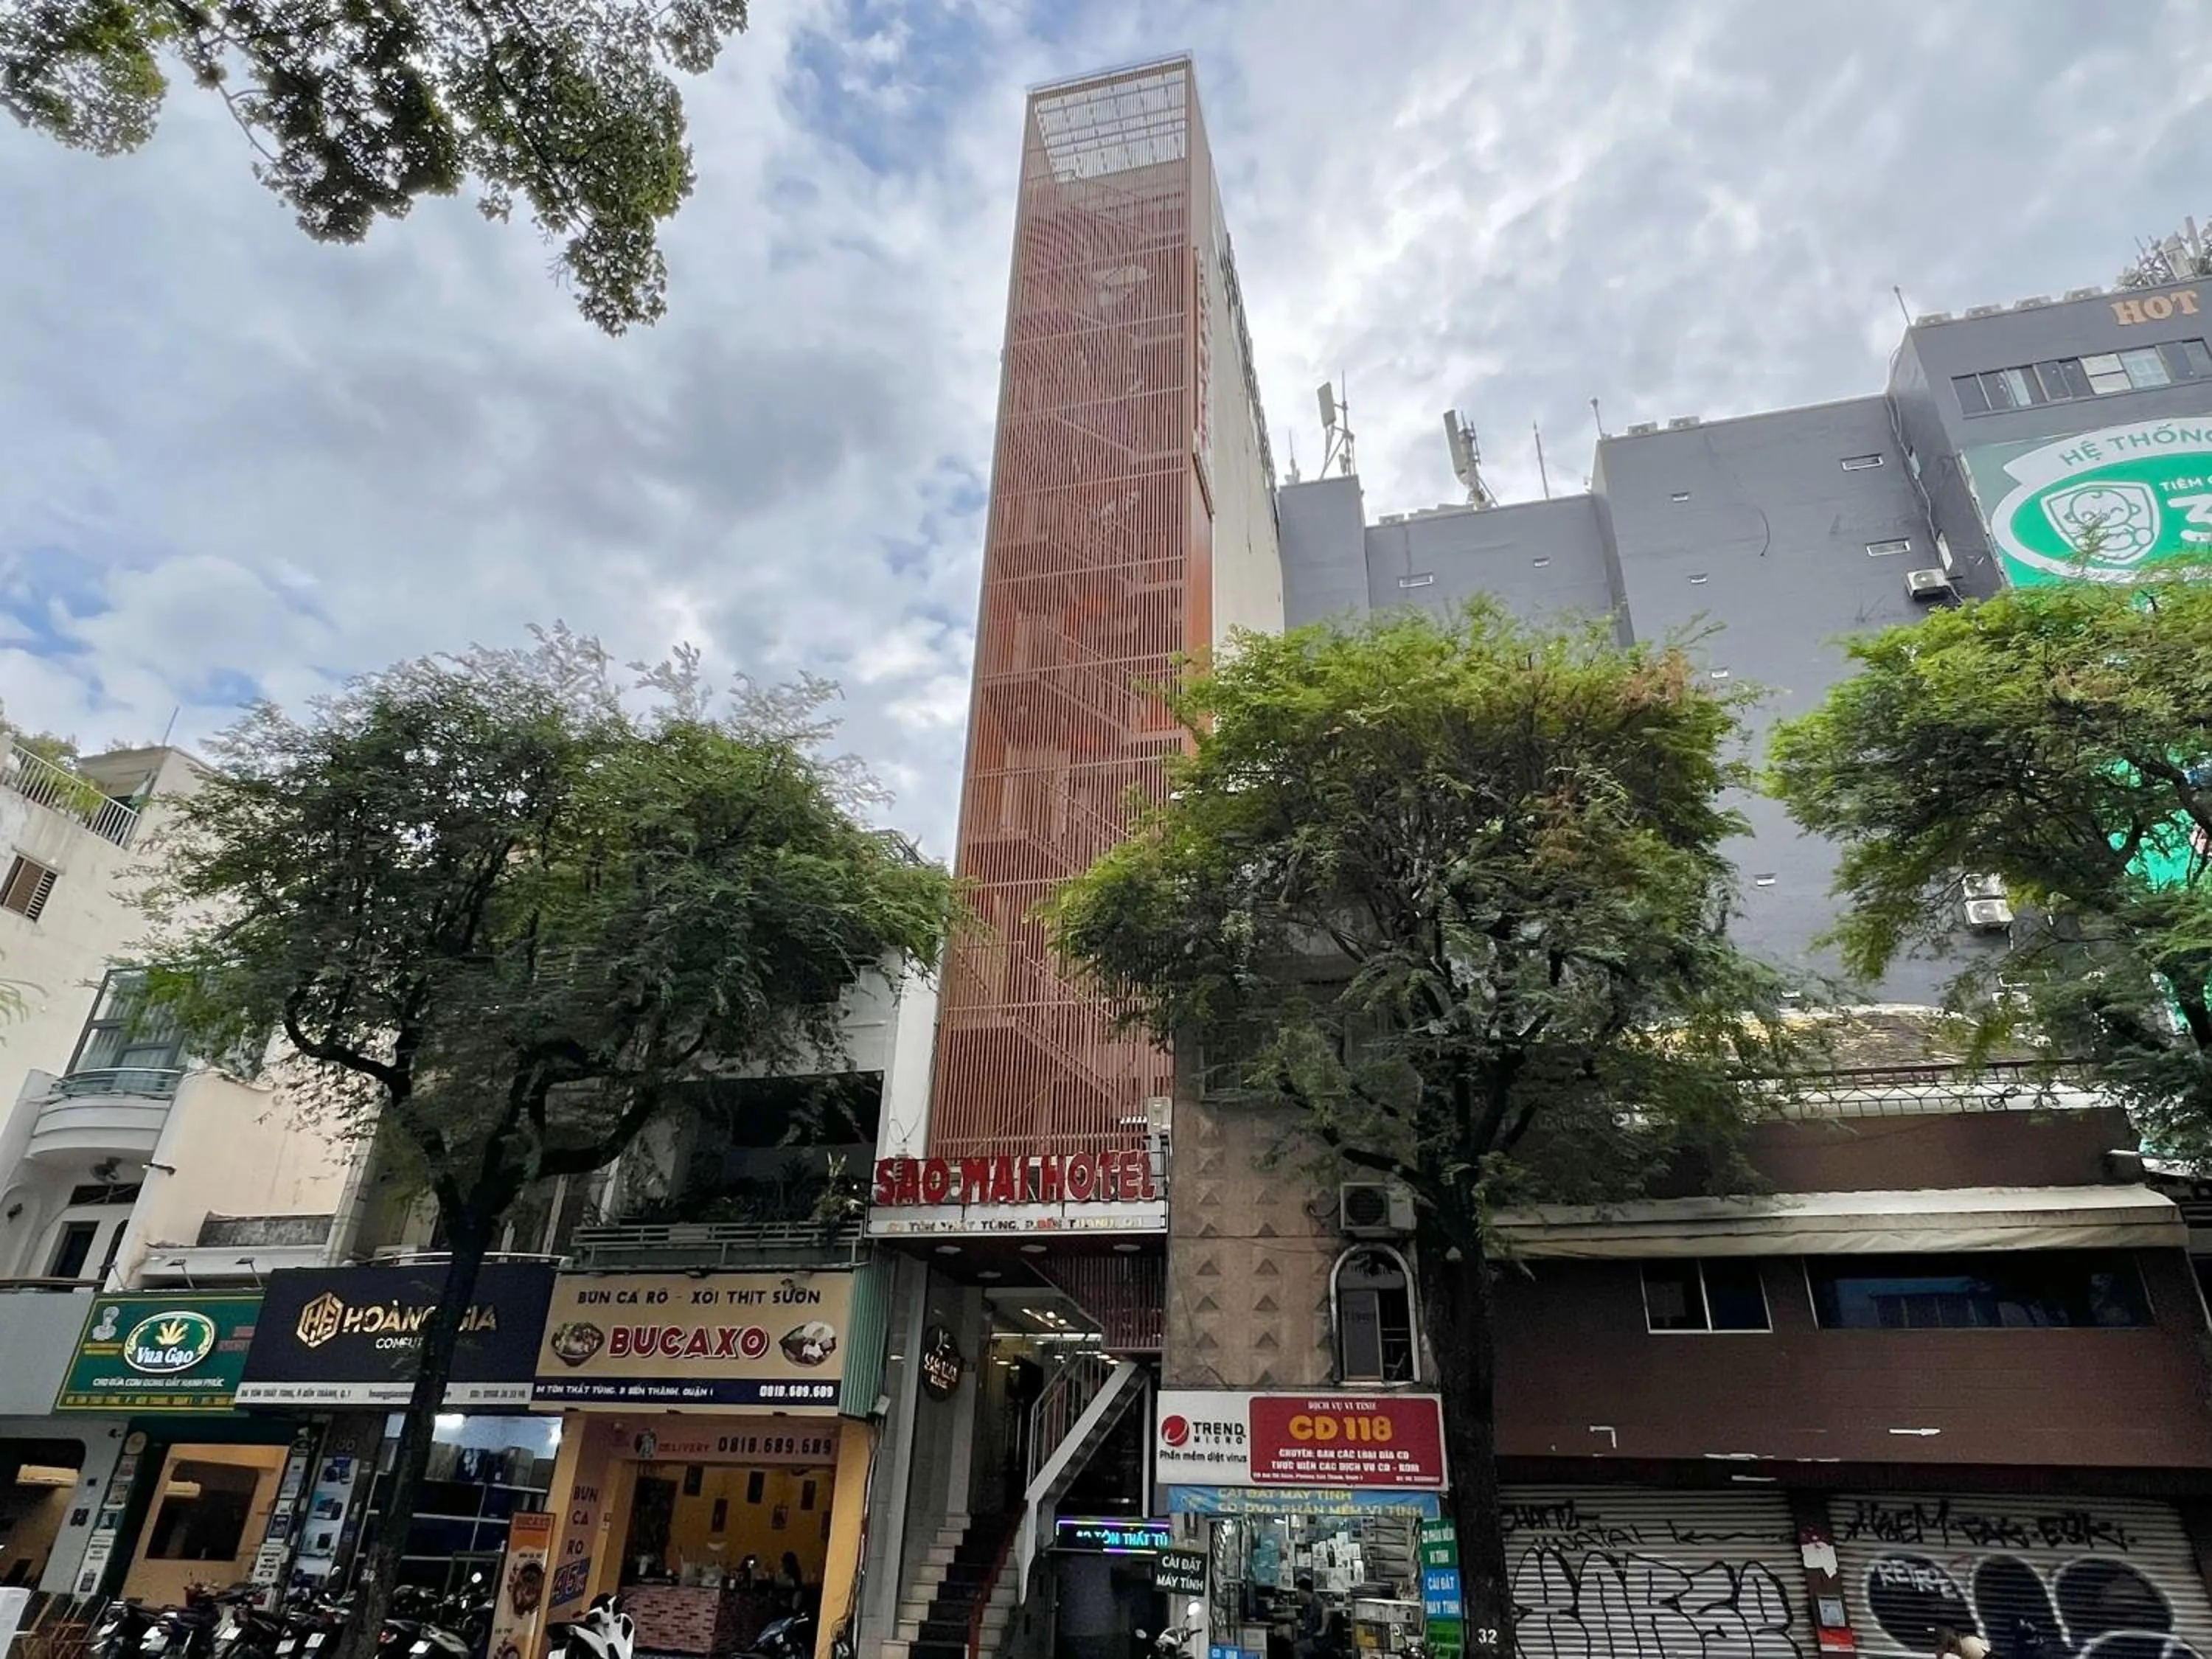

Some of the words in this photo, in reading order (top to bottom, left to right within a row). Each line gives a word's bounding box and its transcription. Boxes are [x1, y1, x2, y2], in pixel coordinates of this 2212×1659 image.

[2059, 441, 2104, 466] HỆ
[2159, 477, 2203, 492] TIÊM
[874, 1156, 950, 1206] SAO
[960, 1155, 1031, 1205] MAI
[1040, 1150, 1157, 1203] HOTEL
[616, 1287, 637, 1304] CÁ
[691, 1287, 718, 1304] XÔI
[727, 1291, 765, 1306] THỊT
[375, 1337, 424, 1349] COMPUT
[608, 1325, 770, 1359] BUCAXO
[136, 1346, 162, 1364] Vua
[164, 1346, 194, 1366] Gạo
[546, 1384, 564, 1394] TÔN
[566, 1382, 589, 1394] THẤT
[1193, 1422, 1245, 1436] TREND
[1289, 1415, 1338, 1441] CD
[1343, 1415, 1393, 1441] 118
[717, 1436, 832, 1455] 0818.689.689
[1194, 1436, 1242, 1444] MICRO
[1160, 1450, 1180, 1461] Phần
[1183, 1450, 1205, 1461] mềm
[1208, 1452, 1224, 1464] diệt
[1227, 1453, 1247, 1462] virus
[1124, 1530, 1148, 1546] THẤT
[1161, 1553, 1179, 1568] CÀI
[1181, 1557, 1202, 1573] ĐẶT
[1156, 1573, 1178, 1587] MÁY
[1180, 1575, 1203, 1590] TÍNH
[1478, 1627, 1498, 1644] 32
